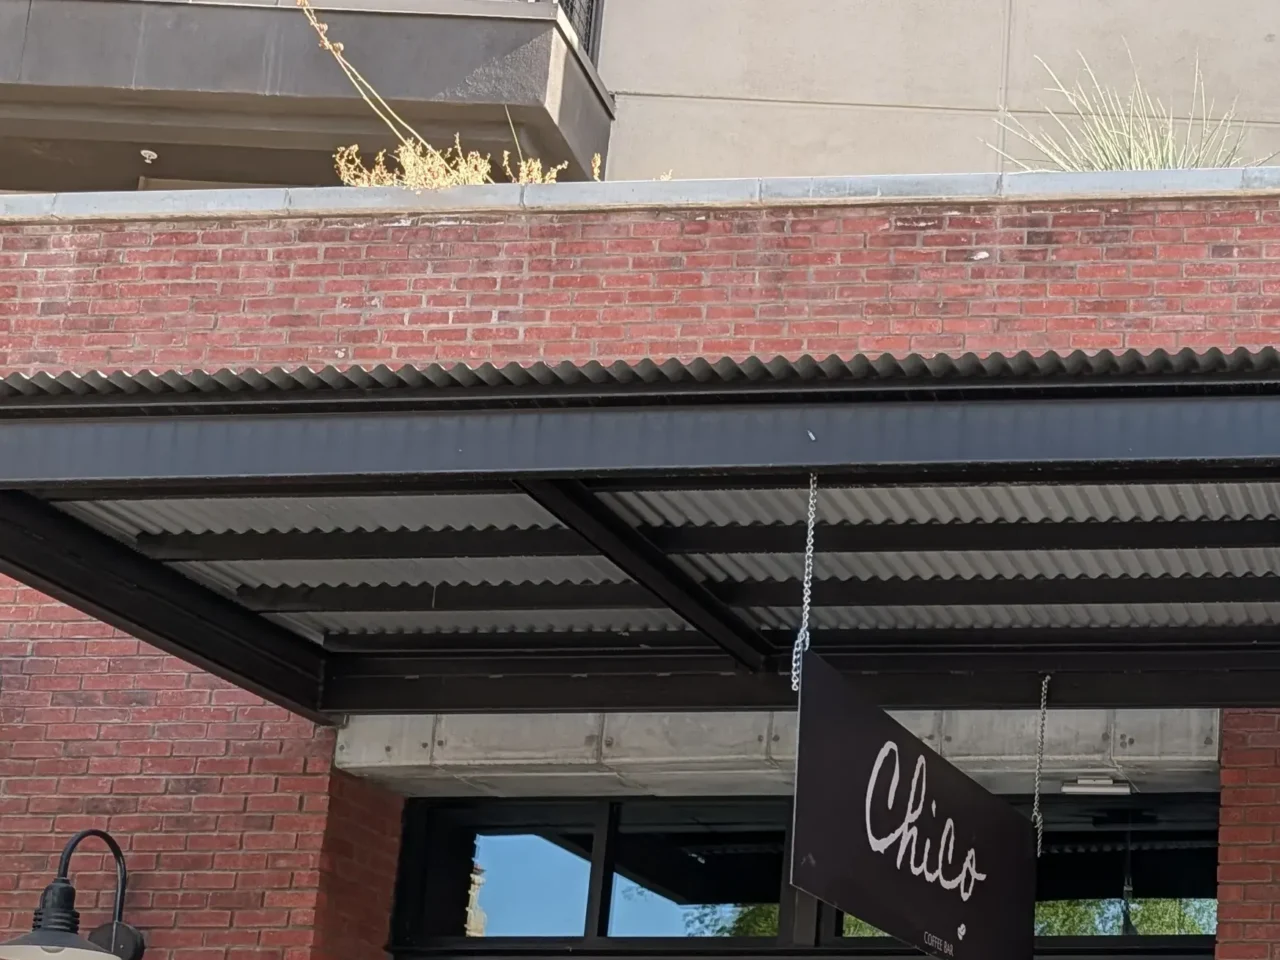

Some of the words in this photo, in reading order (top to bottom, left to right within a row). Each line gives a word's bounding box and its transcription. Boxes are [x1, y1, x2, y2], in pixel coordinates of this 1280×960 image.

[865, 741, 987, 901] Chico
[923, 930, 944, 952] COFFEE
[943, 940, 955, 957] BAR
